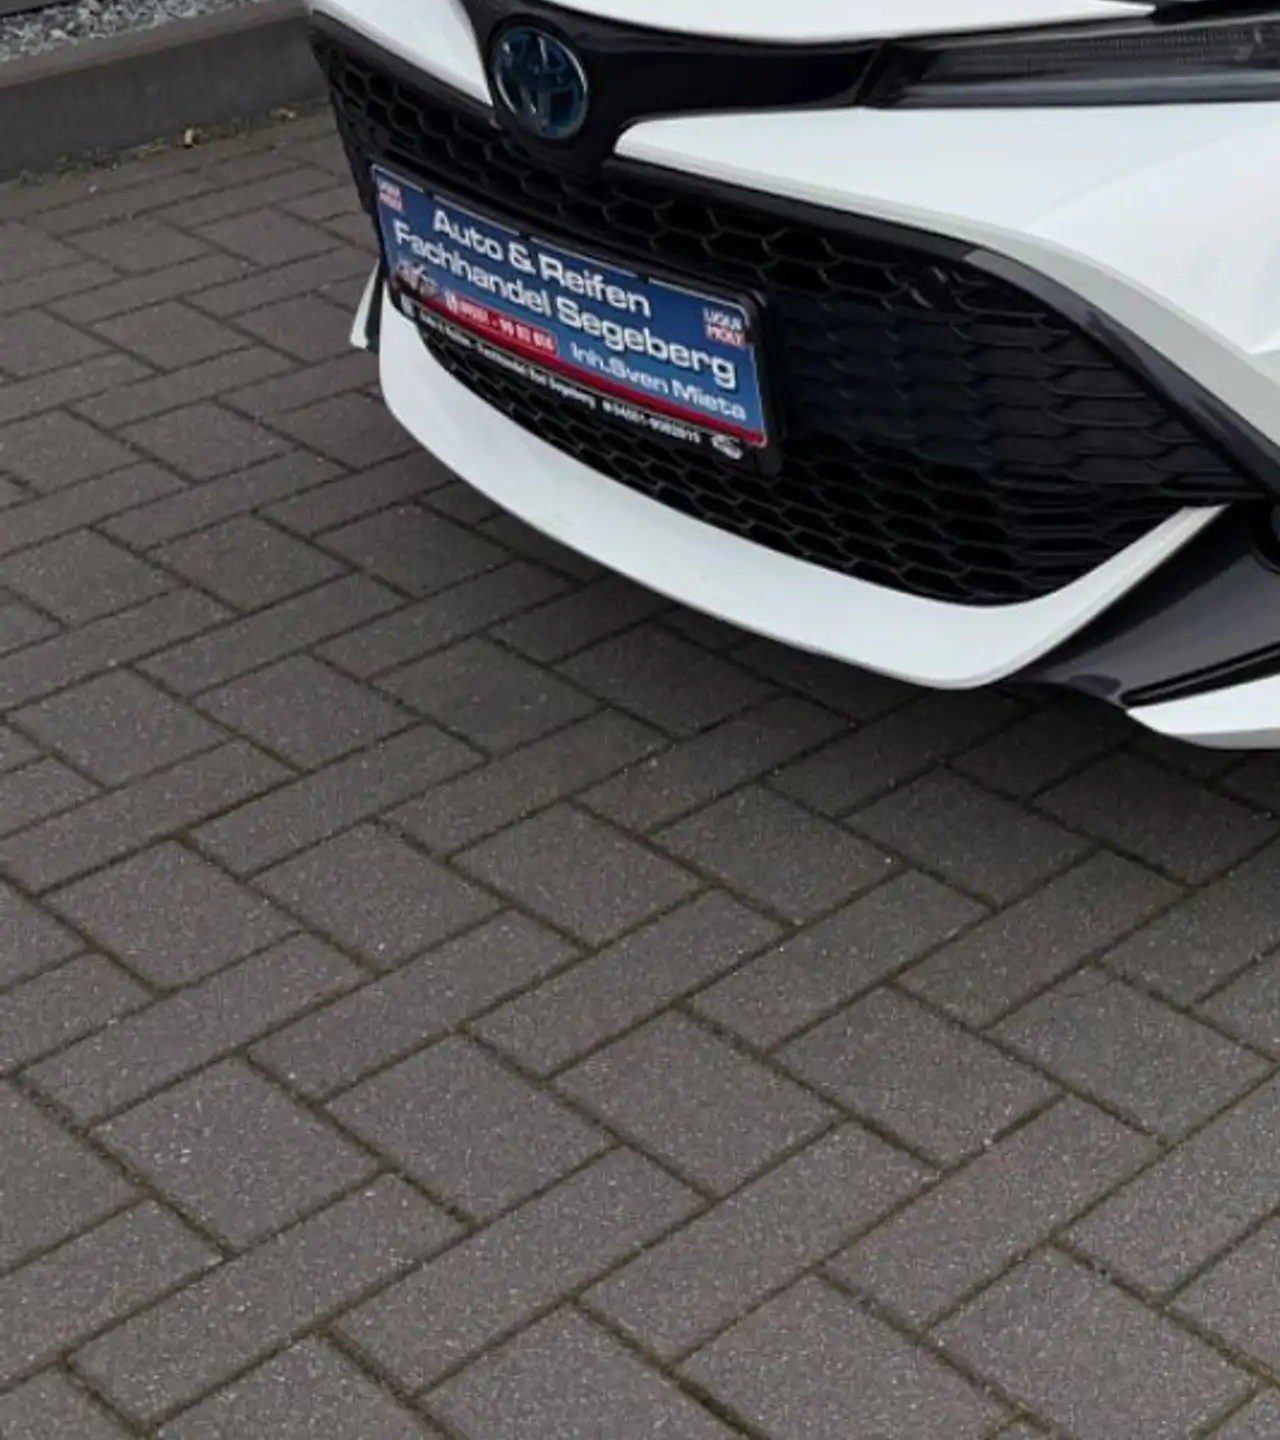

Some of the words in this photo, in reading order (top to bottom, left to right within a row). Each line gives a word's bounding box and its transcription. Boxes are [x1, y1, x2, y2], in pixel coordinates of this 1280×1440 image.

[392, 217, 553, 318] Fachhandel
[555, 295, 738, 391] Segeberg
[433, 208, 504, 262] Auto
[507, 240, 537, 276] &
[537, 252, 652, 319] Reifen
[670, 377, 749, 423] Mieta
